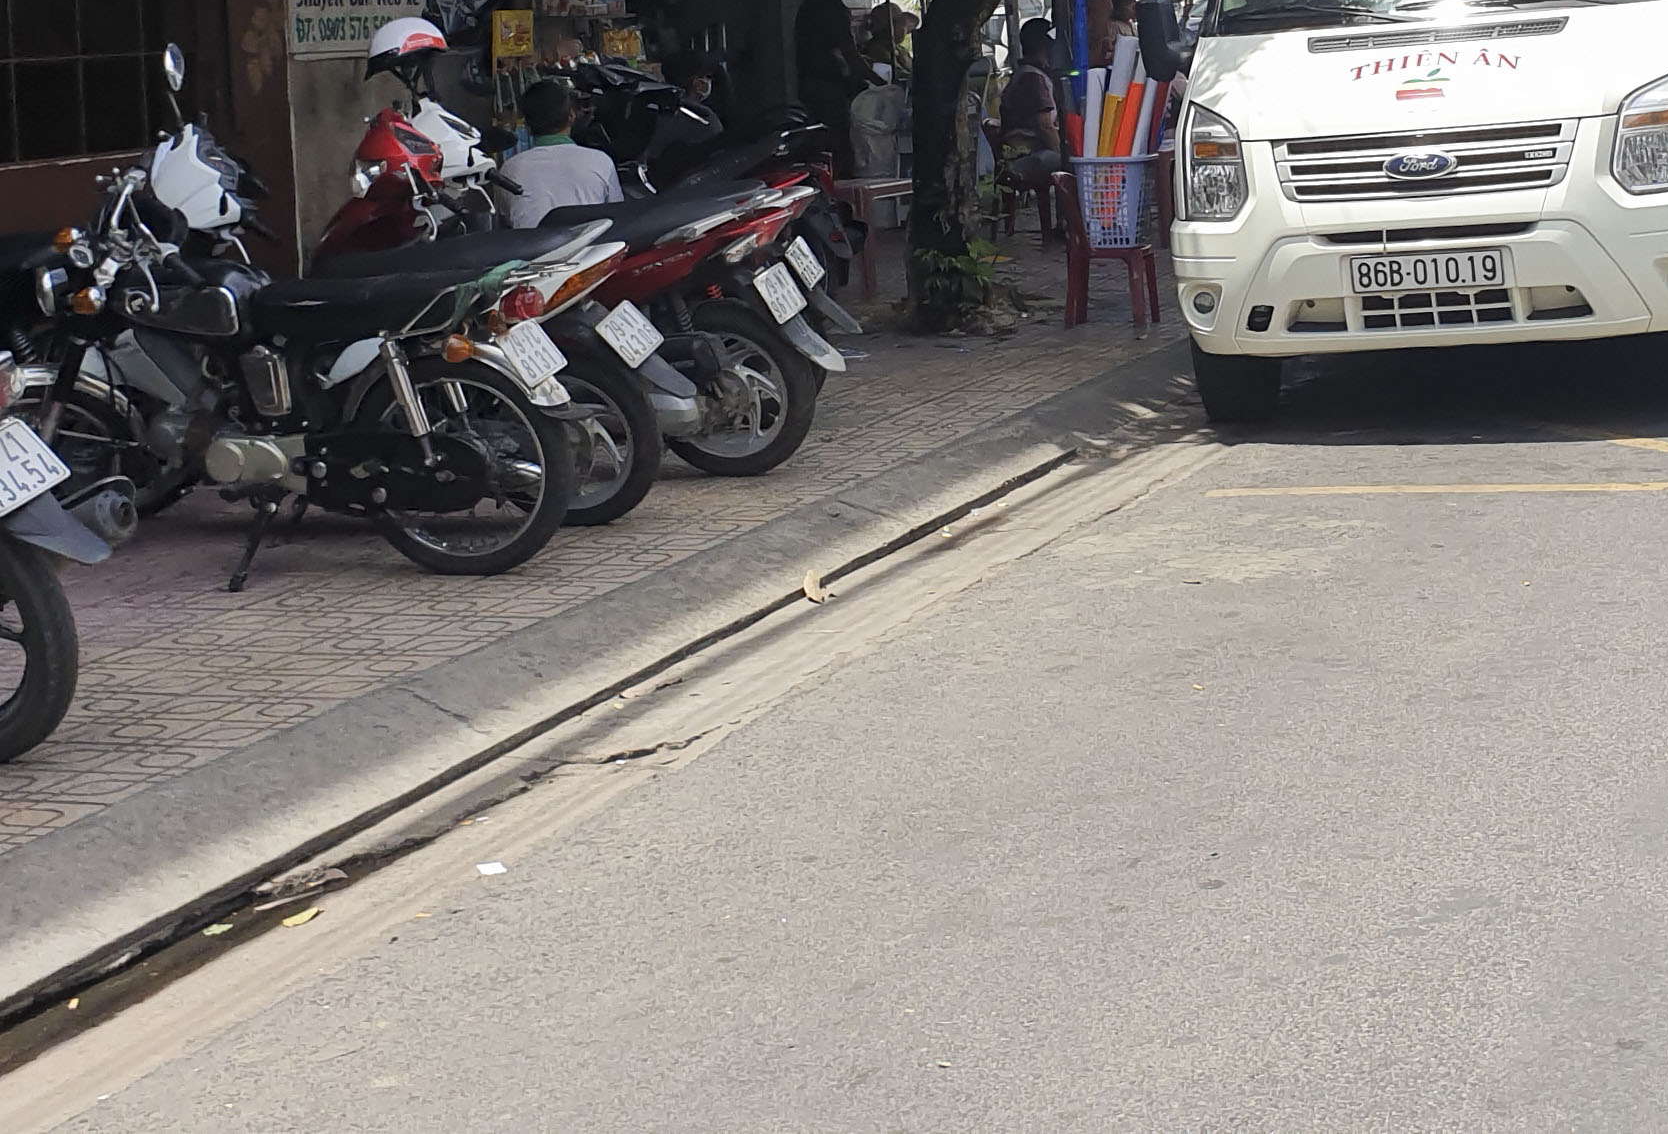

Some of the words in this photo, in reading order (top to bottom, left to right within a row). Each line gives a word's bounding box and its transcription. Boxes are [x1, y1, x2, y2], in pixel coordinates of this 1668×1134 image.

[1350, 50, 1460, 81] THIÊN
[1473, 48, 1522, 70] ÂN
[1398, 154, 1439, 174] Ford
[1357, 254, 1497, 289] 86B-010.19
[0, 452, 61, 508] 34.54
